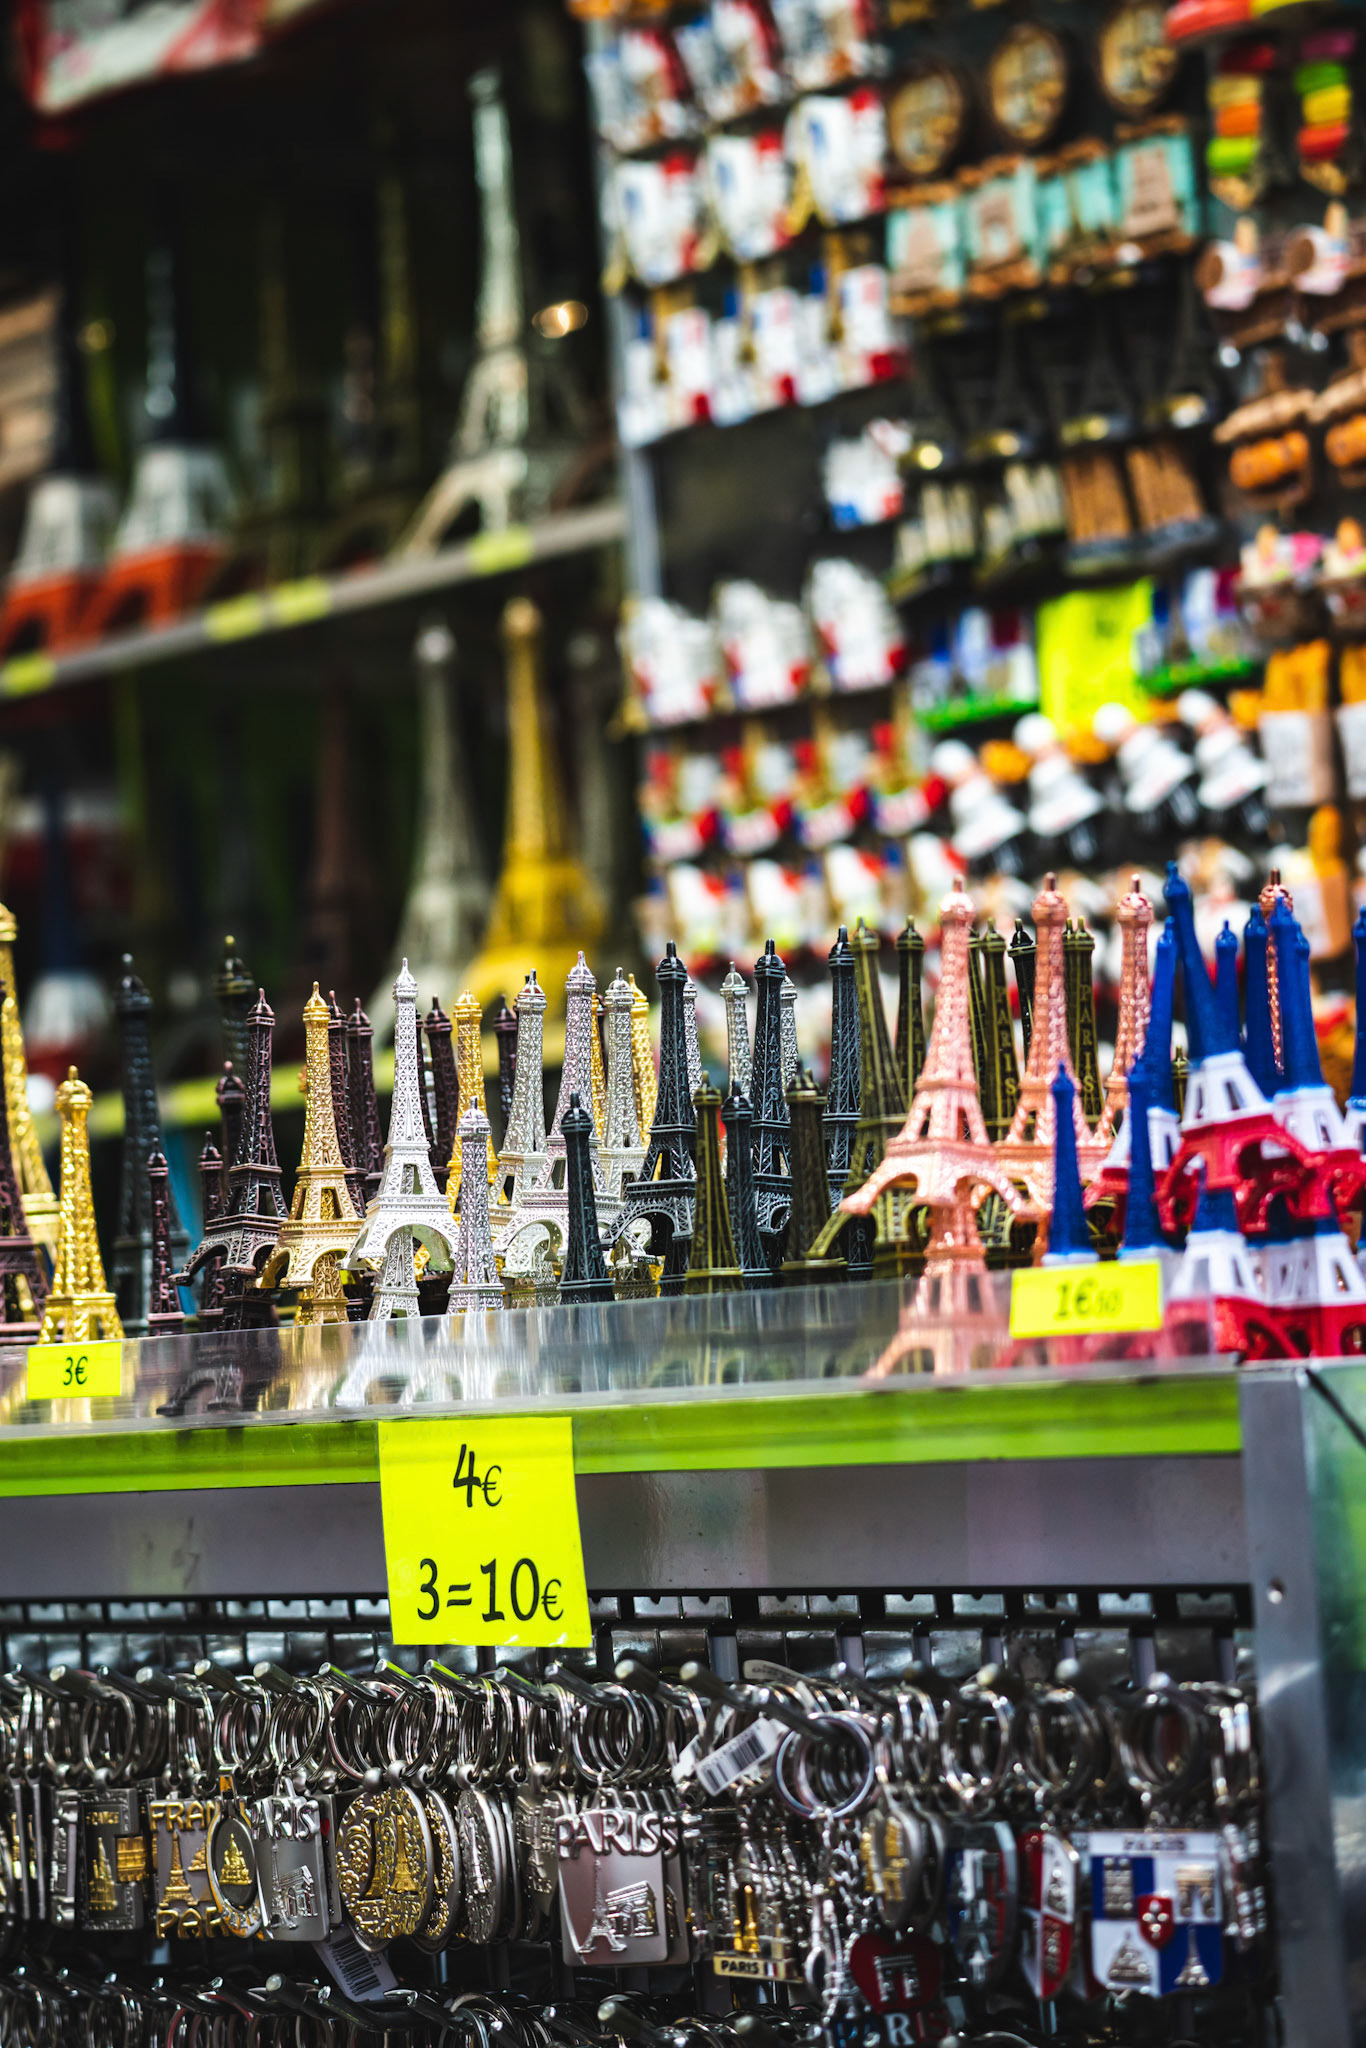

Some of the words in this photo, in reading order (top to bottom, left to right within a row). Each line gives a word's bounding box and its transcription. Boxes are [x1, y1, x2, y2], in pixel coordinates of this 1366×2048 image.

[767, 1015, 780, 1101] PARIS
[995, 985, 1016, 1095] PARIS
[1080, 984, 1095, 1093] PARIS
[259, 1051, 270, 1150] PARIS
[154, 1199, 170, 1300] PARIS
[63, 1355, 88, 1386] 3€
[453, 1443, 503, 1508] 4€
[417, 1557, 564, 1622] 3=10€
[251, 1798, 319, 1841] PARIS
[555, 1809, 661, 1858] PARIS
[721, 1959, 759, 1974] PARIS
